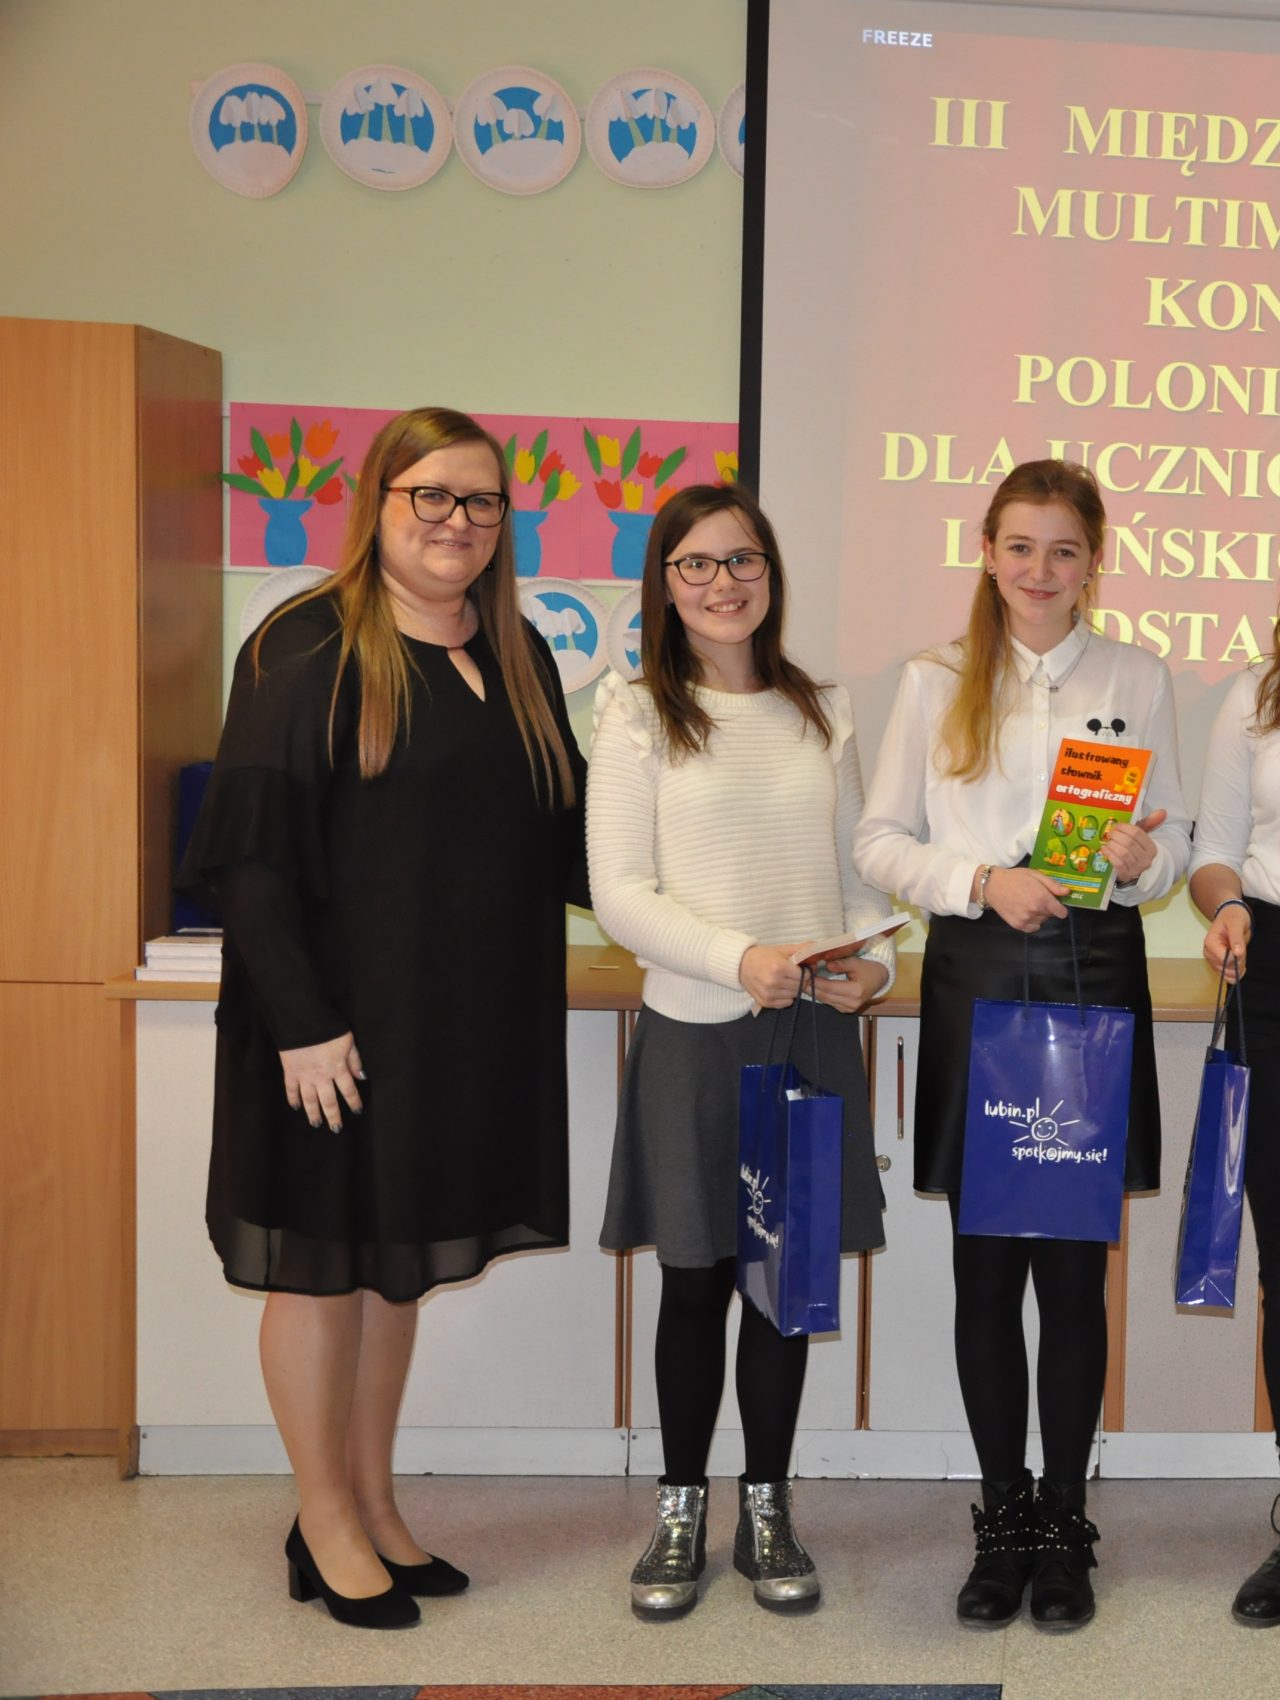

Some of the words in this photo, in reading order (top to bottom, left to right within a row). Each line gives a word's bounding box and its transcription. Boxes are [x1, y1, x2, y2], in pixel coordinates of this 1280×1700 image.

[862, 29, 933, 48] FREEZE
[929, 96, 1010, 150] III
[879, 432, 1018, 485] DLA
[1064, 747, 1130, 769] ilustrowany
[1061, 765, 1103, 781] słownik
[1055, 784, 1134, 806] ortograficzny
[984, 1096, 1040, 1124] lubin.pl
[1011, 1141, 1108, 1165] spotk@jmy.się!
